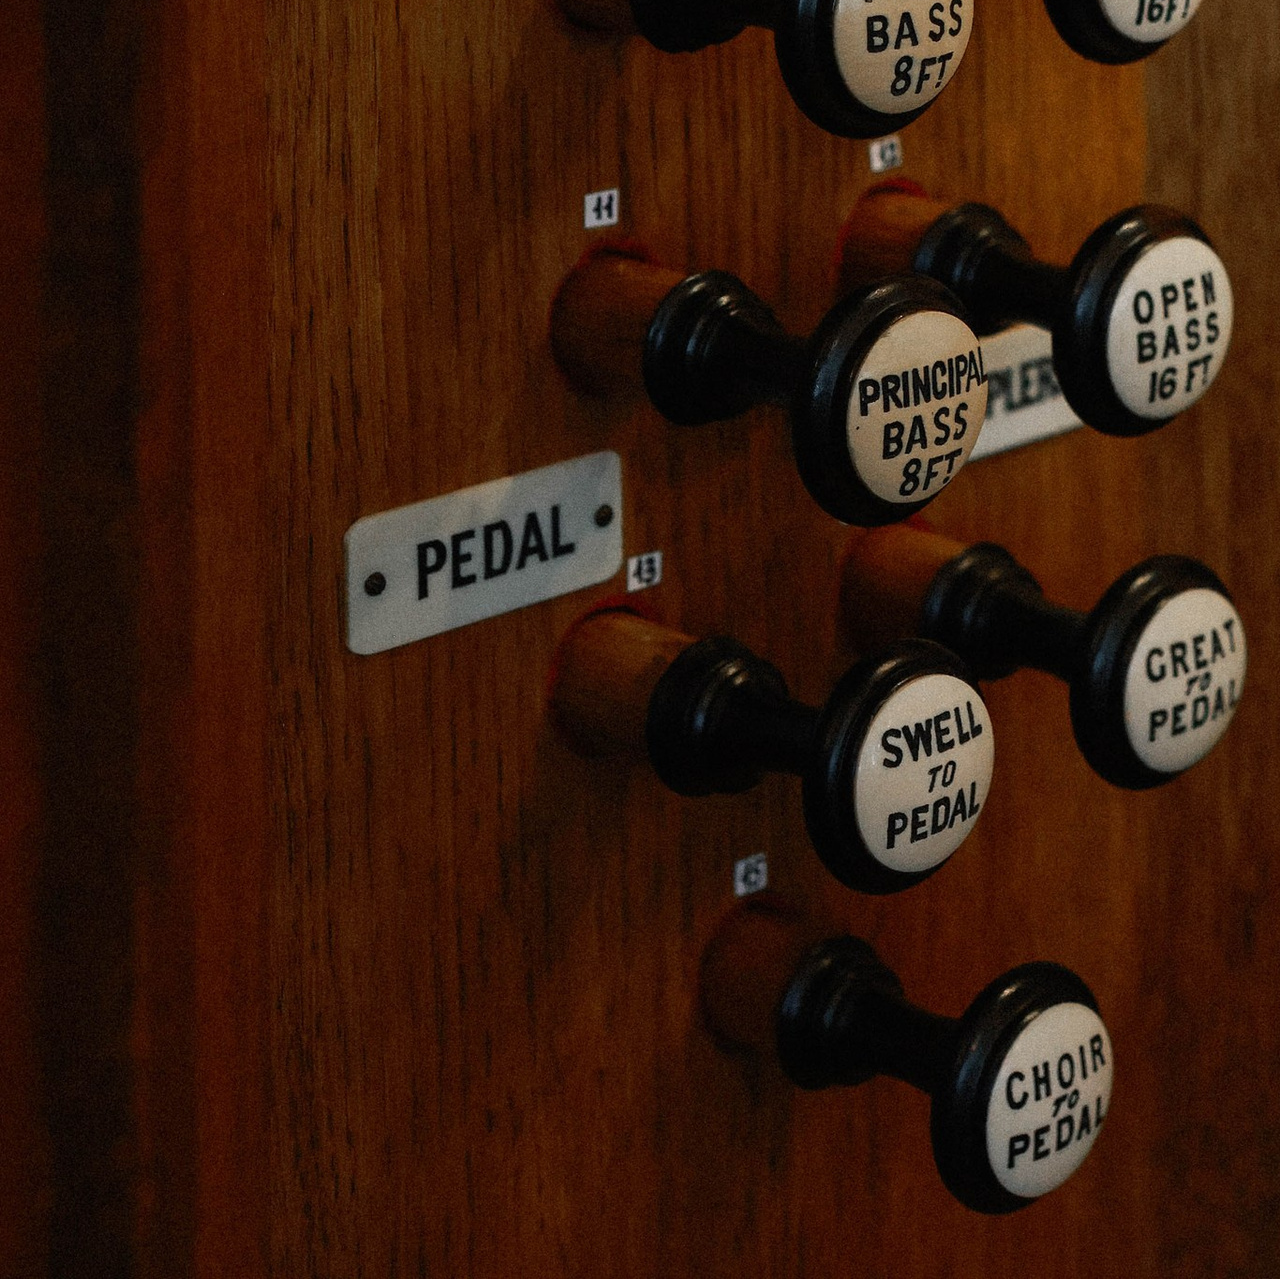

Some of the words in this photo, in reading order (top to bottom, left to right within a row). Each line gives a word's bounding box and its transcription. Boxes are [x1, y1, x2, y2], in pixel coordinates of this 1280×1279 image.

[864, 1, 964, 54] BASS
[1132, 270, 1217, 326] OPEN
[1136, 312, 1221, 366] BASS
[857, 344, 988, 417] PRINCIPAL
[1149, 365, 1176, 403] 16
[881, 402, 969, 461] BASS
[414, 504, 577, 601] PEDAL
[1146, 618, 1236, 685] GREAT
[1147, 678, 1240, 744] PEDAL
[1185, 671, 1213, 697] TO
[880, 700, 983, 770] SWELL
[927, 758, 957, 794] TO
[884, 780, 981, 849] PEDAL
[1005, 1033, 1106, 1111] CHOIR
[1052, 1088, 1079, 1118] TO
[1006, 1095, 1107, 1170] PEDAL
